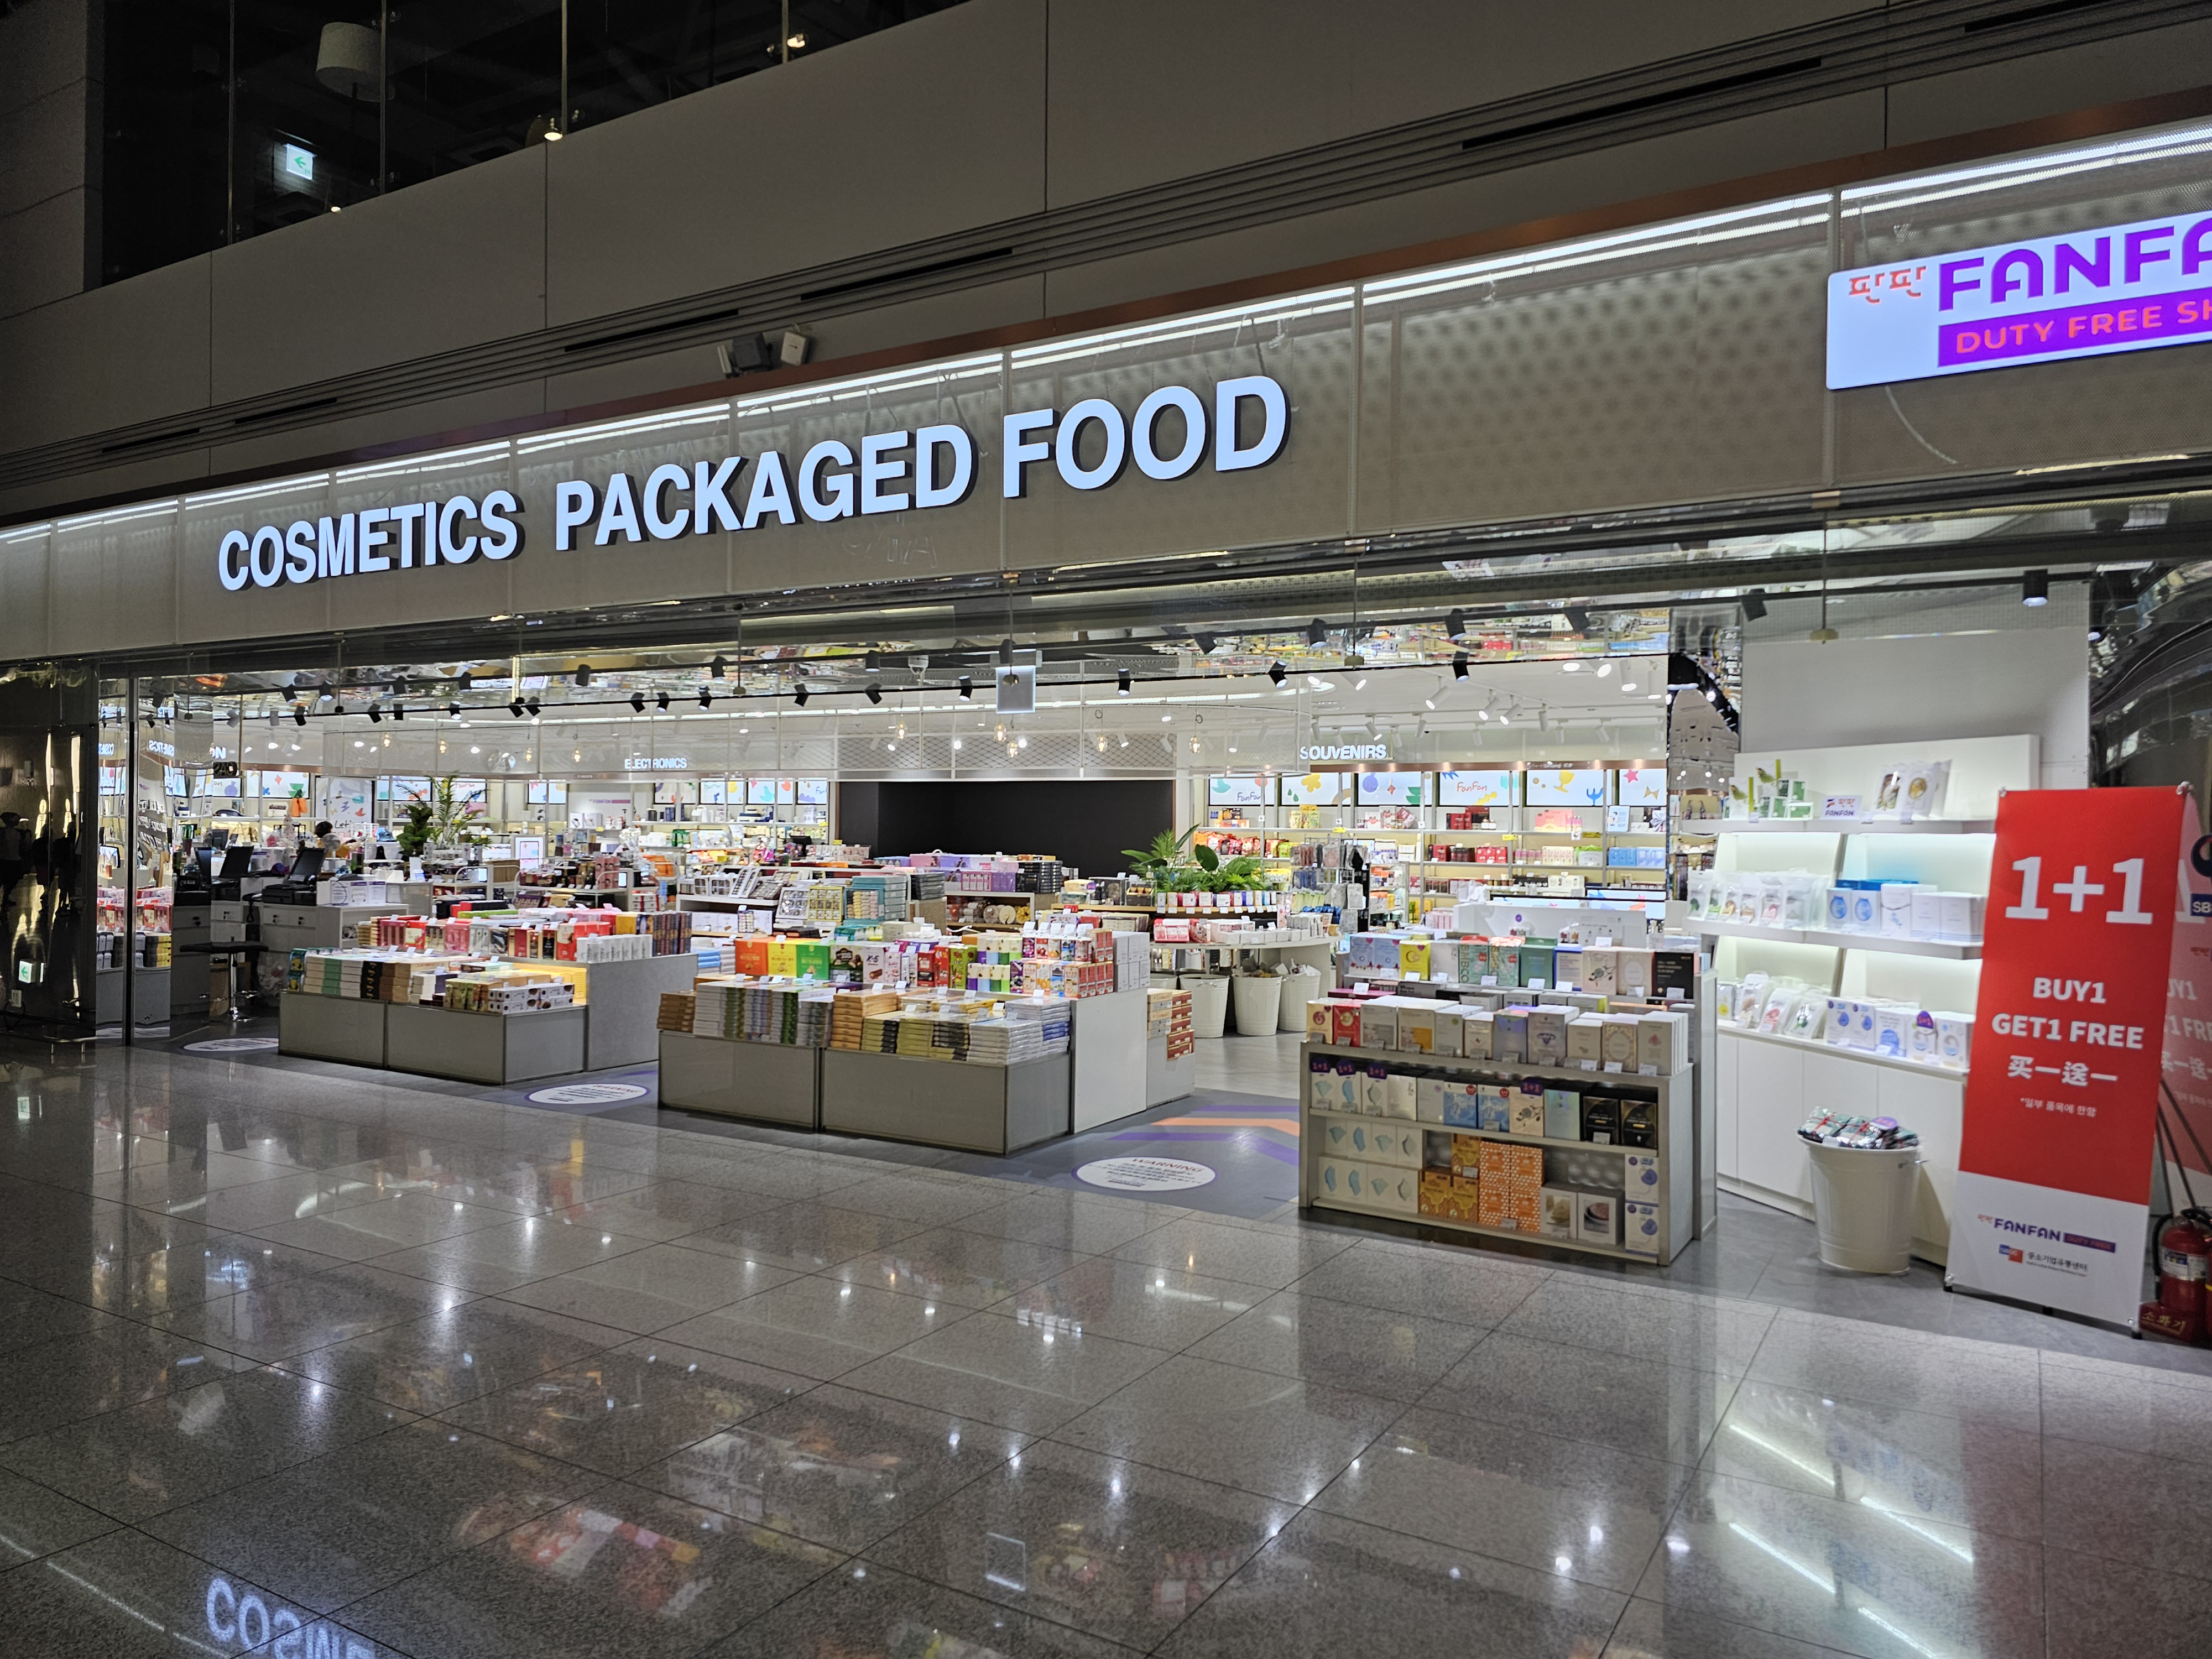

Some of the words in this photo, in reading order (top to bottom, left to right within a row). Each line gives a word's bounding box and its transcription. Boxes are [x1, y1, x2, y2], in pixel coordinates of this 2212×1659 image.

[1956, 320, 2054, 354] DUTY
[2068, 305, 2163, 338] FREE
[218, 490, 519, 591] COSMETICS
[556, 424, 972, 551] PACKAGED
[1003, 375, 1287, 499] FOOD
[1300, 744, 1387, 760] SOUVENIRS
[1457, 781, 1488, 792] FanFan
[2005, 856, 2153, 925] 1+1
[2033, 977, 2107, 1004] BUY1
[1992, 1013, 2062, 1041] GET1
[2069, 1021, 2145, 1050] FREE
[2007, 1055, 2118, 1087] 买一送一
[1994, 1218, 2061, 1241] FANFAN
